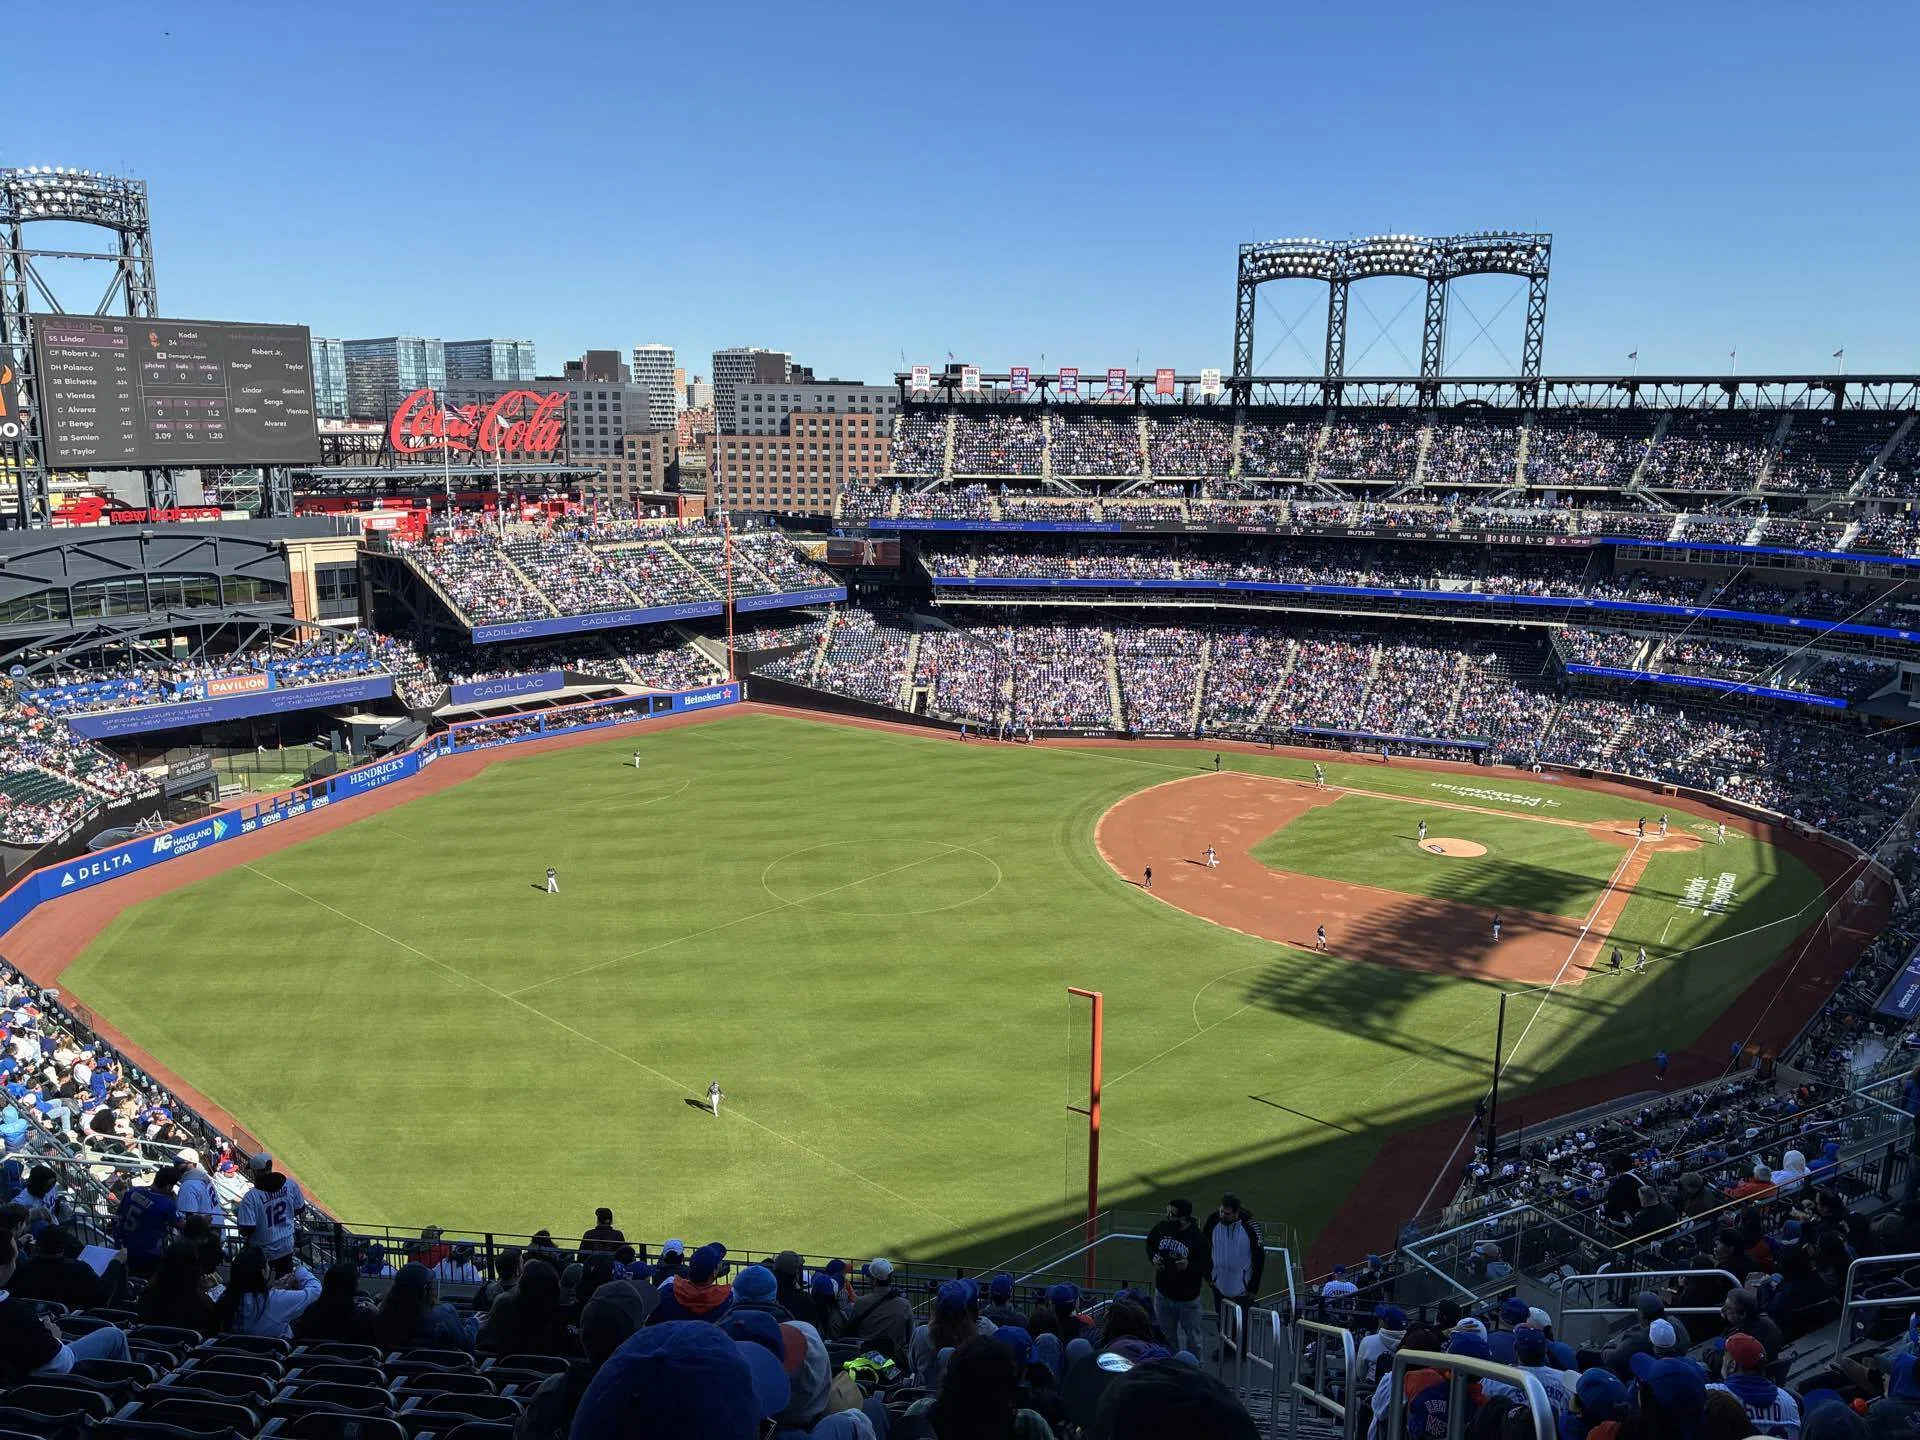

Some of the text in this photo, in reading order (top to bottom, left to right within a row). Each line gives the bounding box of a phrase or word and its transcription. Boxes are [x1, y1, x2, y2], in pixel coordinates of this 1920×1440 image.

[72, 448, 96, 456] Taylor
[110, 510, 147, 522] new
[804, 591, 838, 600] CADILLAC
[748, 598, 784, 607] CADILLAC
[675, 604, 720, 616] CADILLAC
[581, 614, 632, 626] CADILLAC
[477, 626, 534, 640] CADILLAC
[212, 679, 266, 693] PAVILION
[473, 679, 544, 696] CADILLAC
[684, 690, 720, 705] Heineken
[102, 717, 140, 725] OFFICIAL
[144, 712, 176, 720] LUXURY
[614, 714, 650, 725] CADILLAC
[474, 738, 517, 750] CADILLAC
[440, 747, 451, 756] 370
[350, 758, 404, 784] HENDRICK'S
[371, 776, 387, 787] GIN
[312, 796, 329, 808] GOYA
[288, 804, 306, 816] GOYA
[262, 812, 281, 824] GOYA
[241, 820, 256, 832] 380
[173, 827, 212, 847] HAUGLAND
[174, 841, 199, 855] GROUP
[79, 854, 132, 880] DELTA
[262, 1186, 288, 1204] LINDOR
[265, 1202, 287, 1228] 12
[1160, 1238, 1189, 1258] SPARTANS
